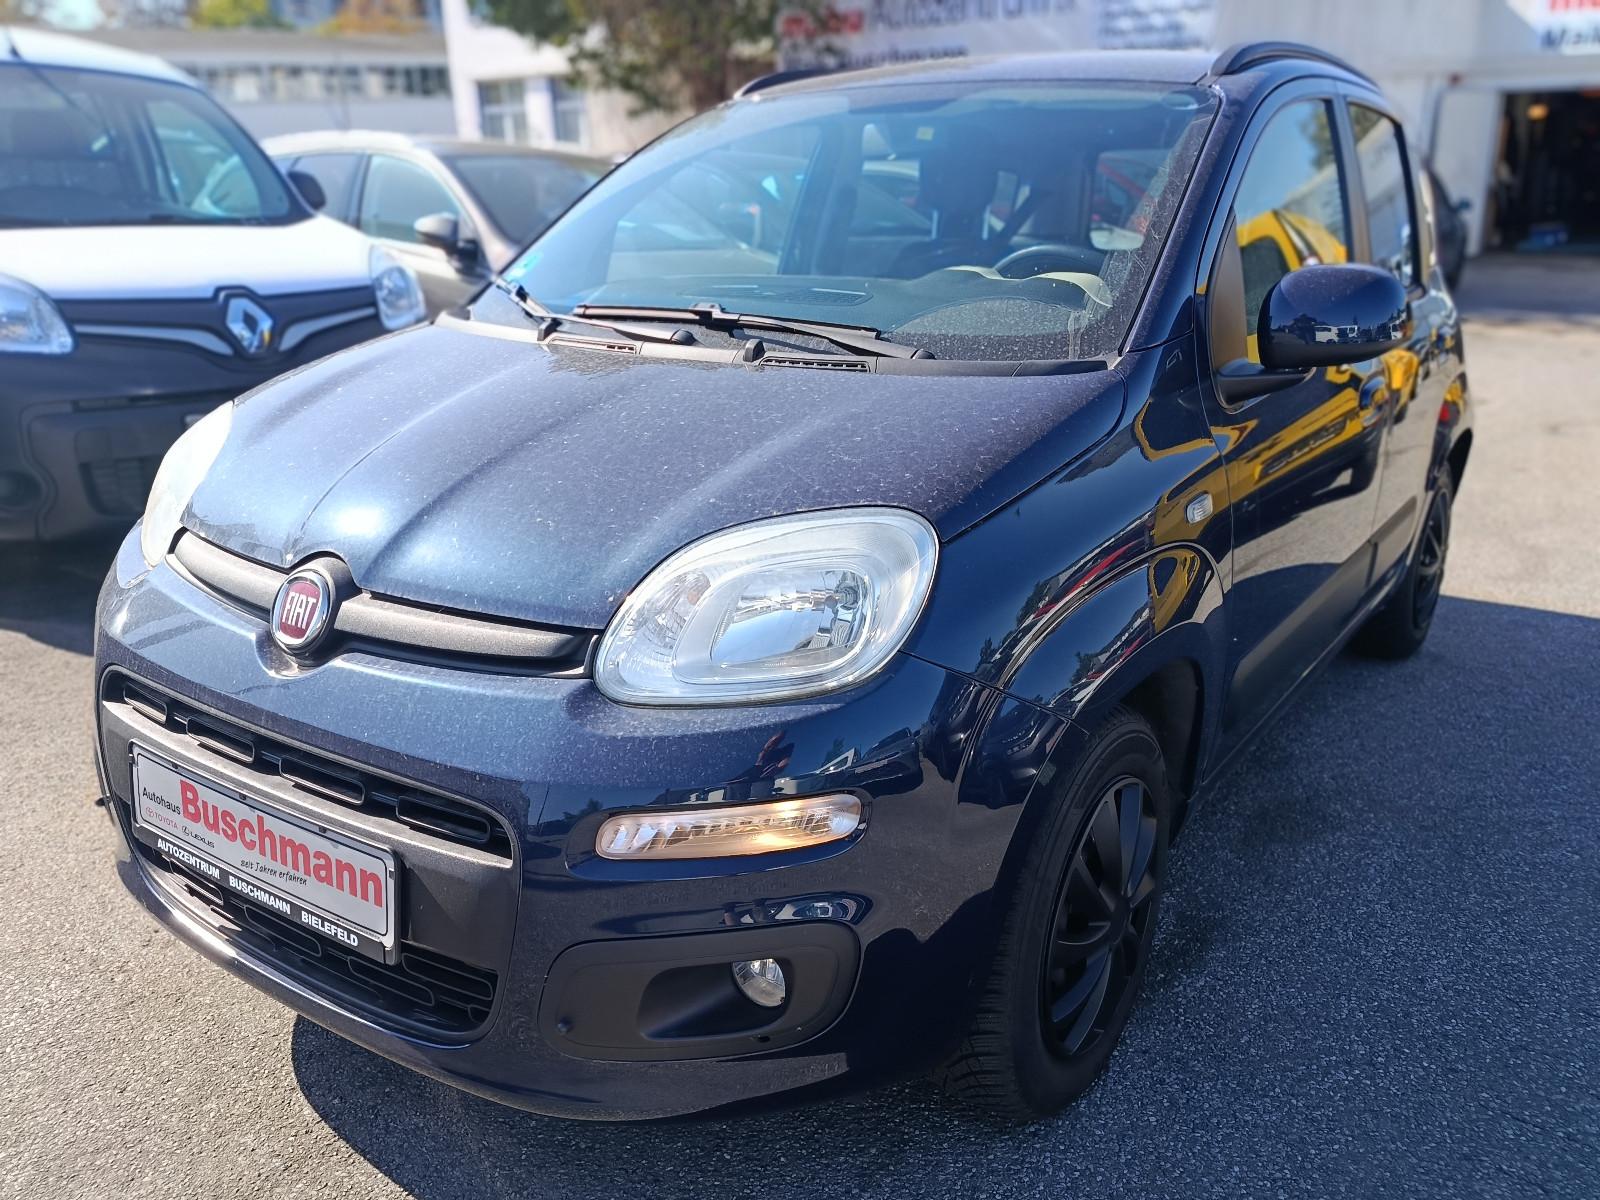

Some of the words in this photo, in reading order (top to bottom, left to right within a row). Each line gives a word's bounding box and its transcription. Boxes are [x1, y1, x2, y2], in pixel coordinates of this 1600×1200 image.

[282, 591, 317, 629] FIAT
[154, 811, 179, 829] TOYOTA
[142, 787, 181, 815] Autohaus
[180, 780, 383, 908] Buschmann
[190, 832, 215, 848] LEXUS
[254, 862, 277, 877] Jahren
[278, 870, 307, 885] erfahren
[157, 839, 221, 879] AUTOZENTRUM
[228, 875, 291, 914] BUSCHMANN
[301, 911, 358, 946] BIELEFELD
